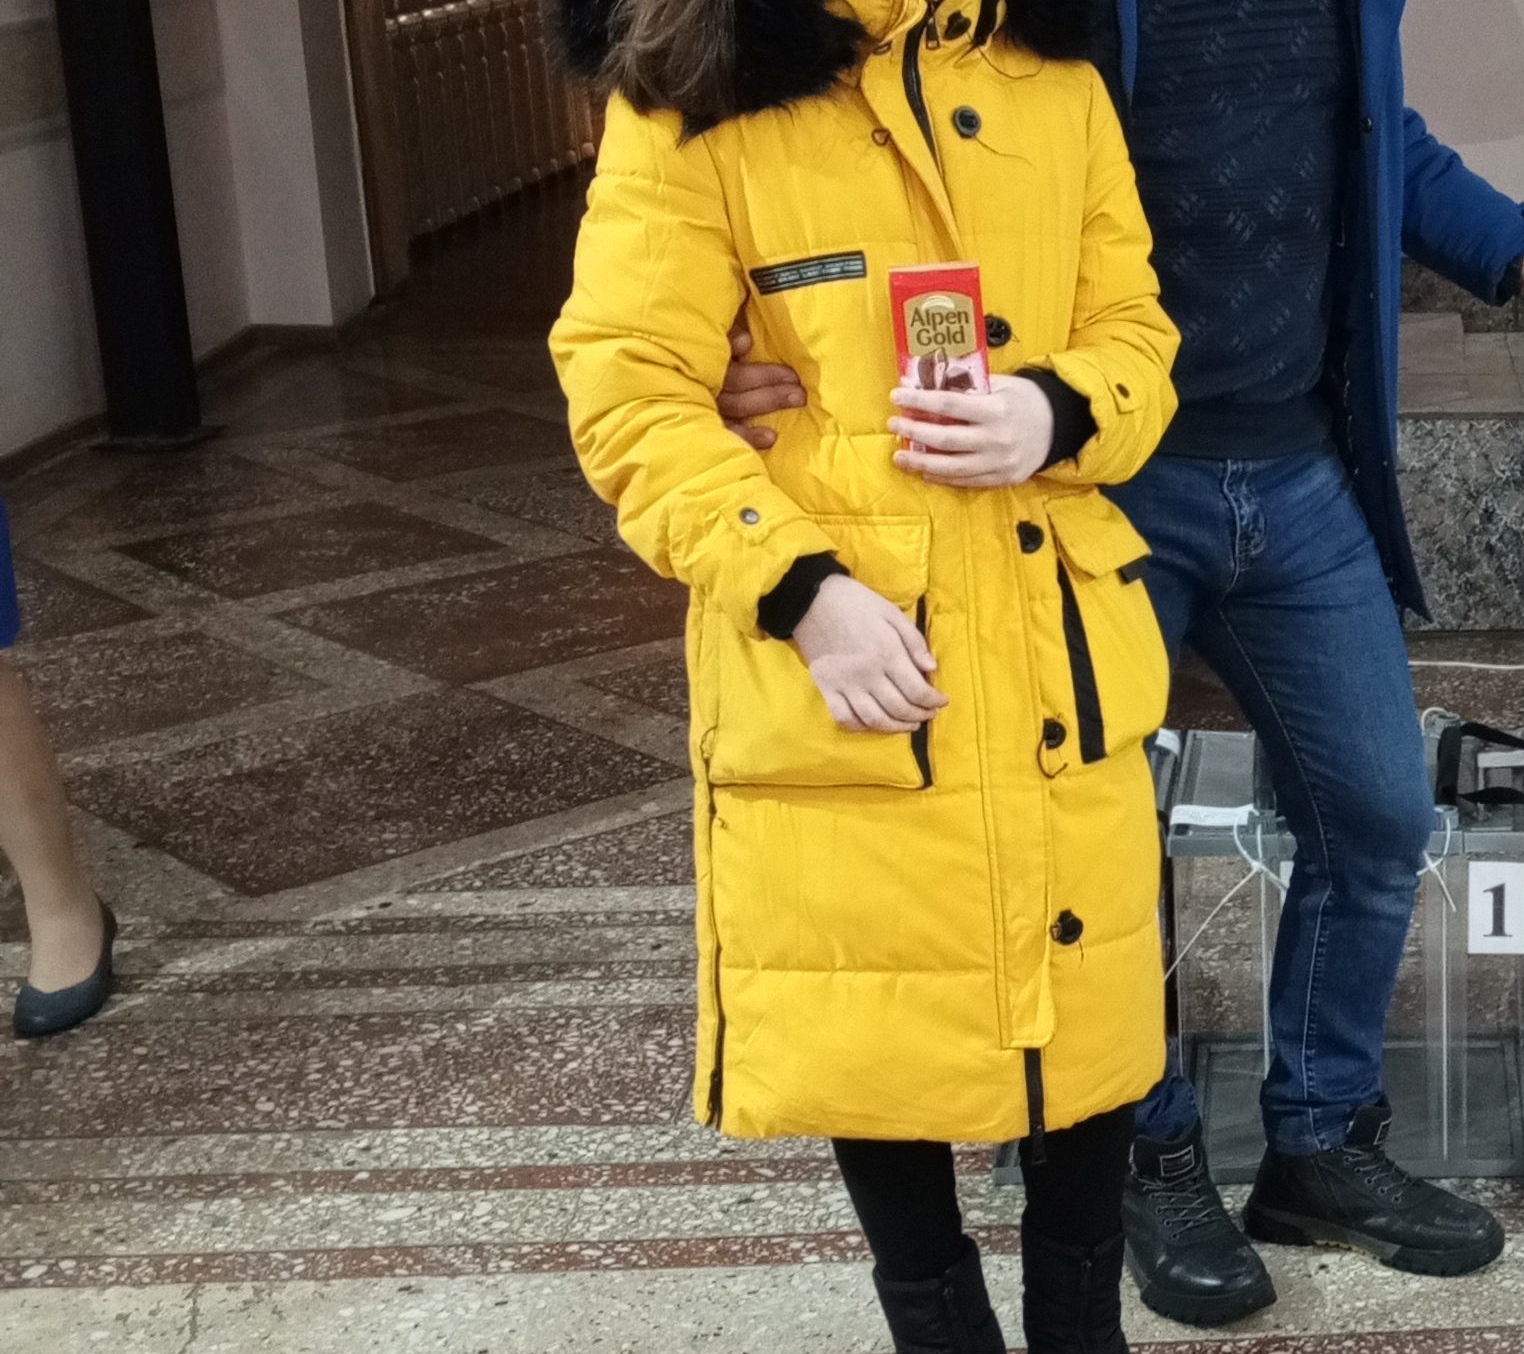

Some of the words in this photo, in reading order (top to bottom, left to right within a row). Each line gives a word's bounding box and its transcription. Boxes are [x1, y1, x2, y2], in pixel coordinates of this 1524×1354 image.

[910, 307, 970, 332] Alpen
[916, 325, 966, 347] Gold
[1483, 882, 1513, 938] 1
